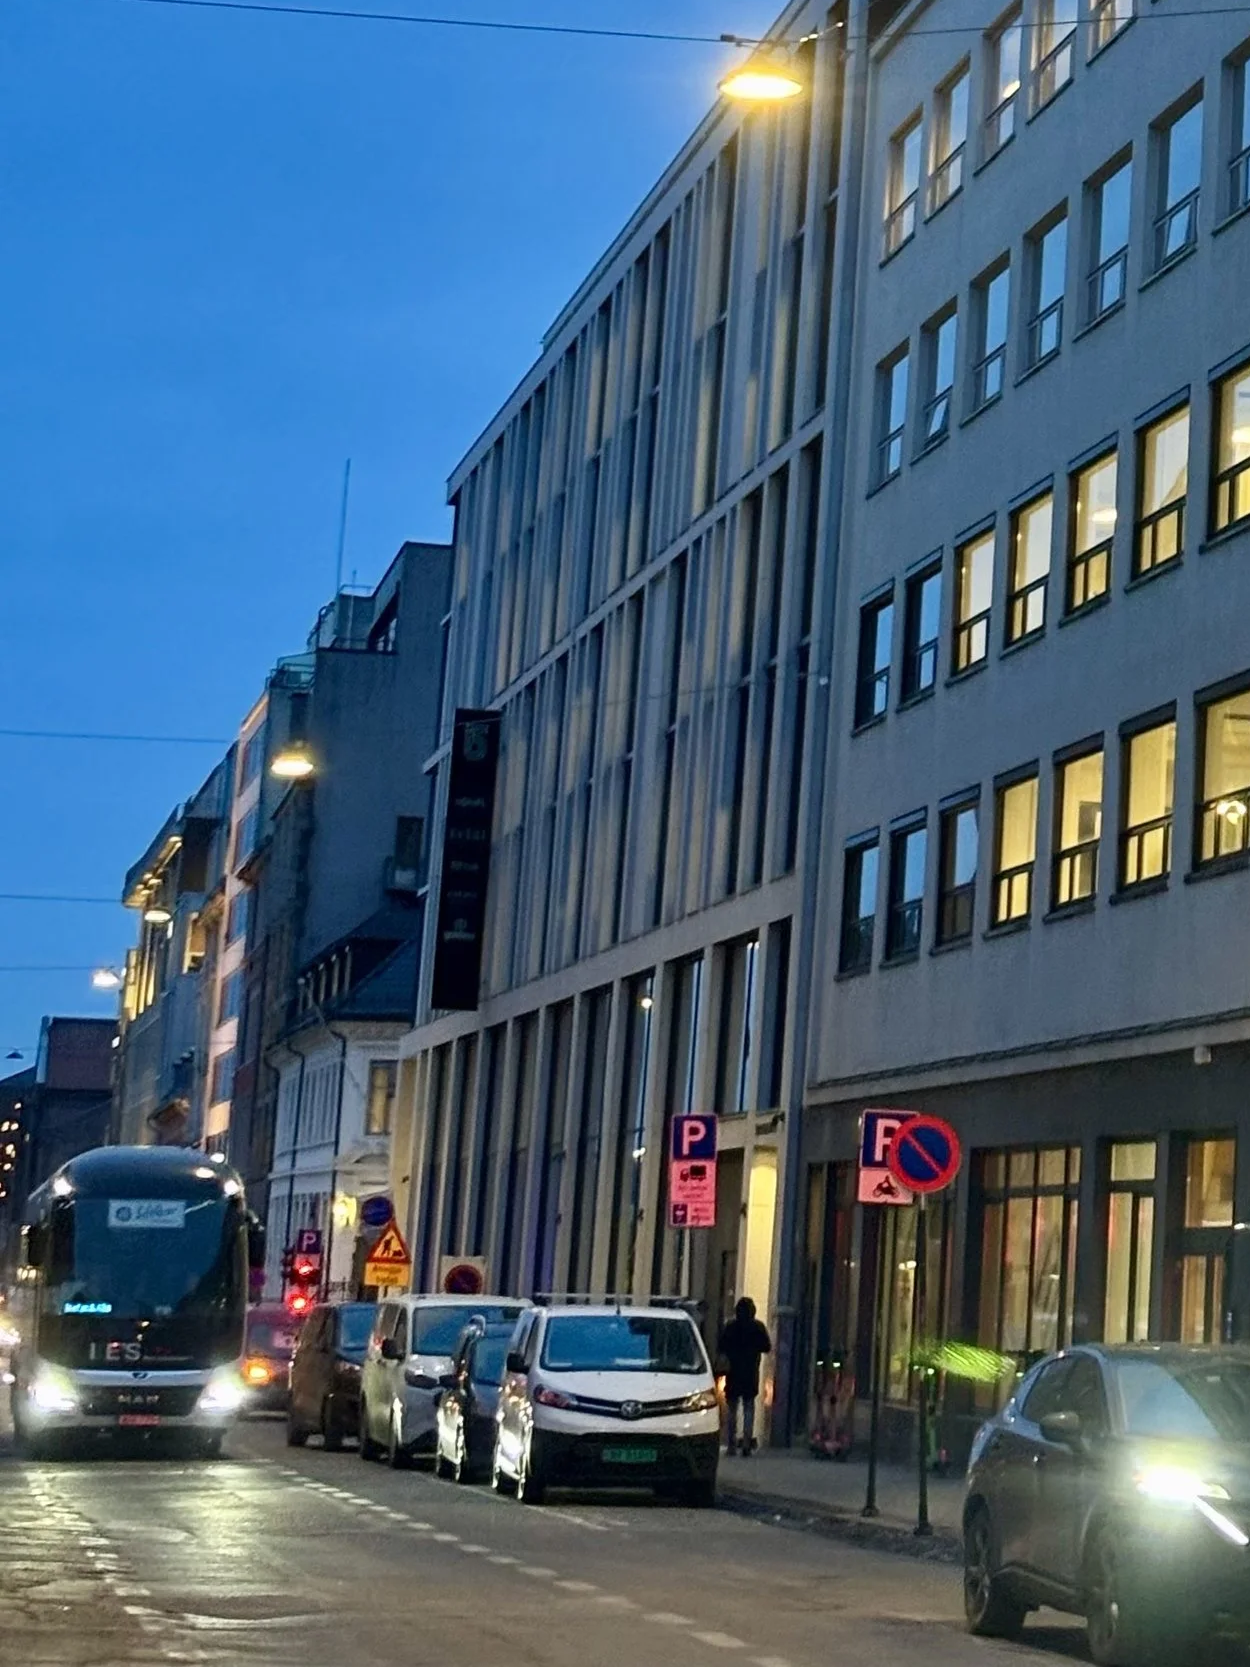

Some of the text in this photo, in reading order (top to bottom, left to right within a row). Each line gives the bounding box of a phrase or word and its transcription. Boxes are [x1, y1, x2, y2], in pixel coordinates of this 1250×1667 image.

[682, 1119, 707, 1156] P
[873, 1117, 903, 1162] P
[302, 1232, 316, 1251] P
